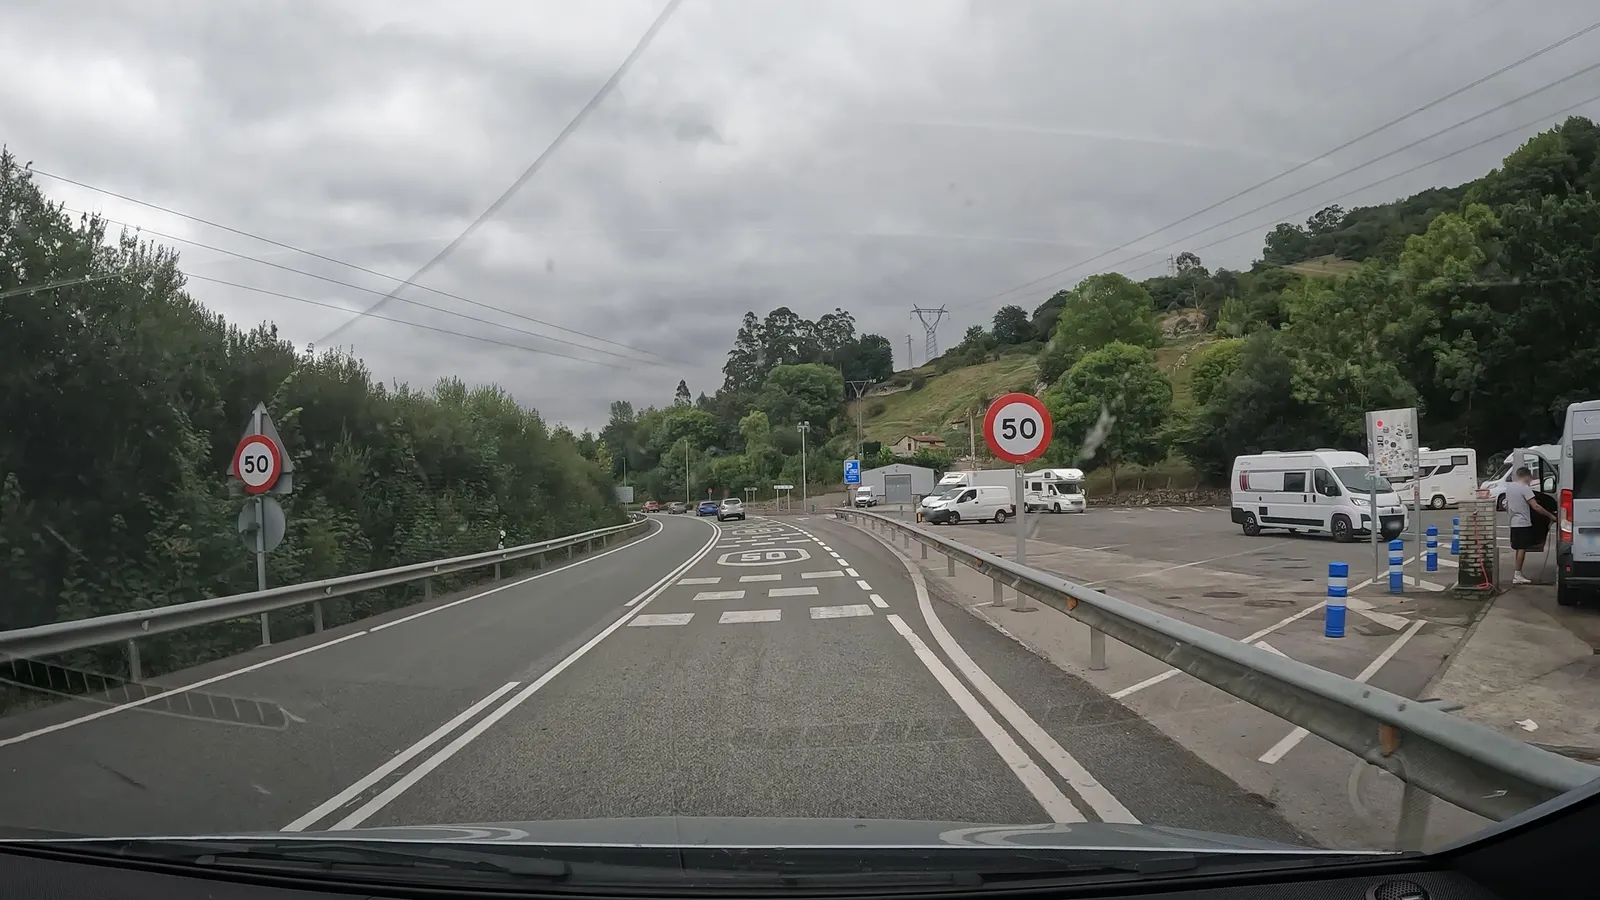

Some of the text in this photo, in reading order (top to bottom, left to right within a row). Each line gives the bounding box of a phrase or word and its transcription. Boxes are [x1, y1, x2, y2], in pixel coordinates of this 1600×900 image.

[1002, 418, 1037, 440] 50
[244, 455, 269, 474] 50
[846, 462, 853, 471] P
[740, 551, 787, 562] 50
